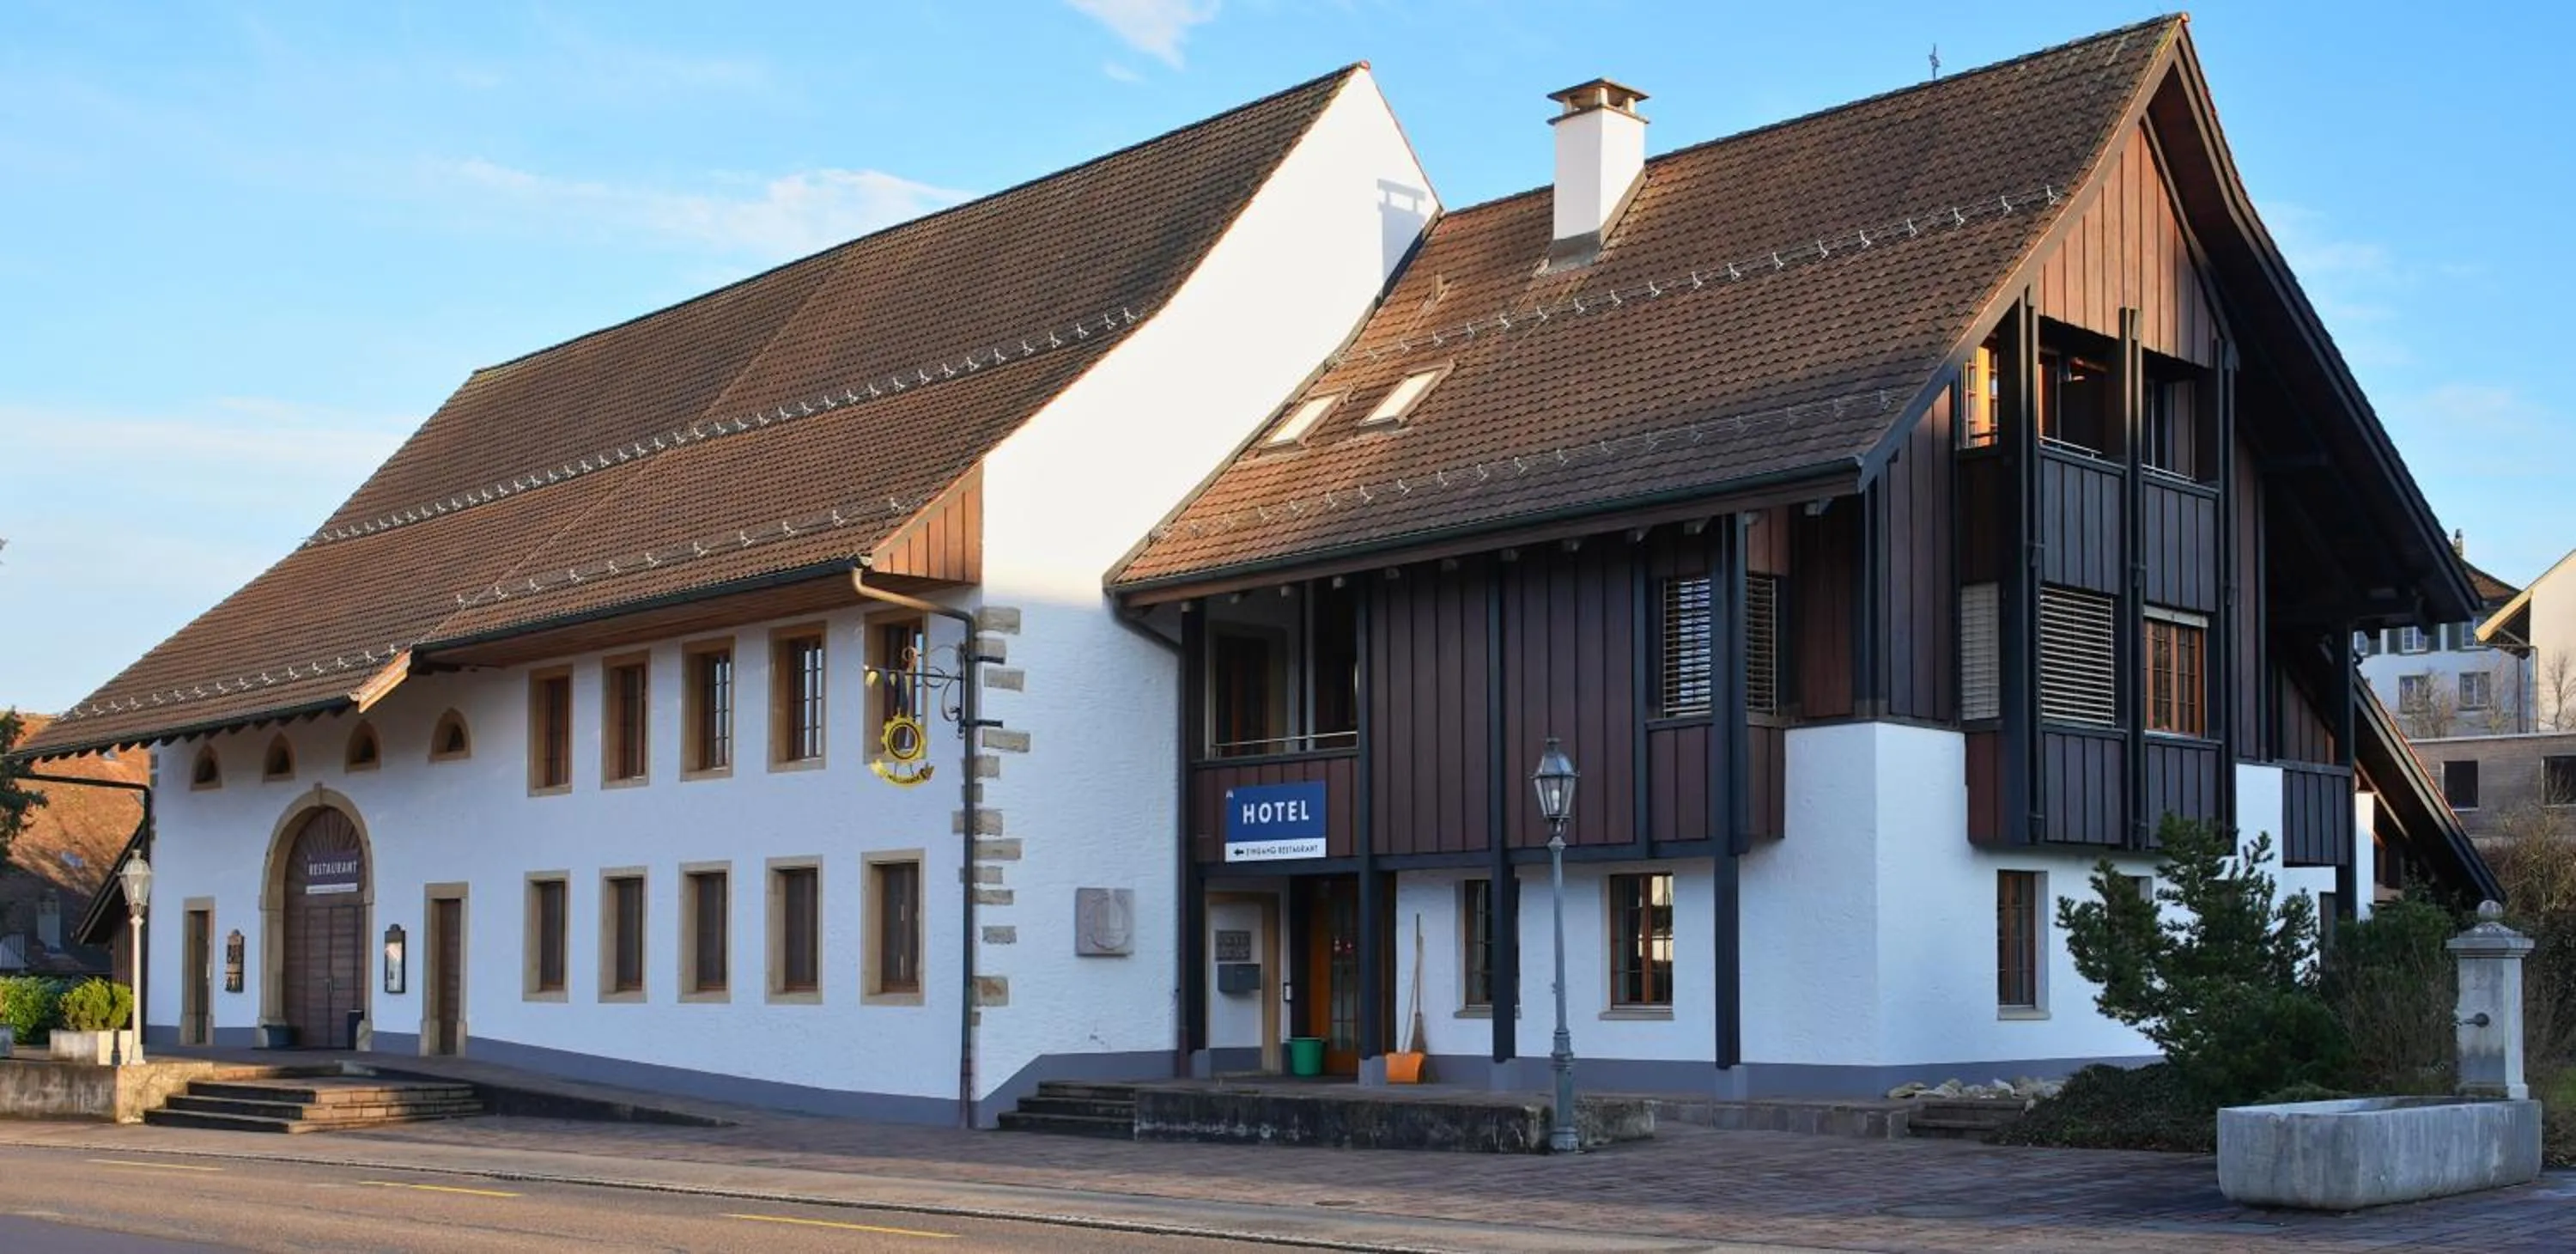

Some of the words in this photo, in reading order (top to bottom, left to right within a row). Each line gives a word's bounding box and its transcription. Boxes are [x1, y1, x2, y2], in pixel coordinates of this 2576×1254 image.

[1242, 800, 1309, 825] HOTEL
[1278, 844, 1318, 855] RESTAURANT
[309, 861, 357, 876] RESTAURANT
